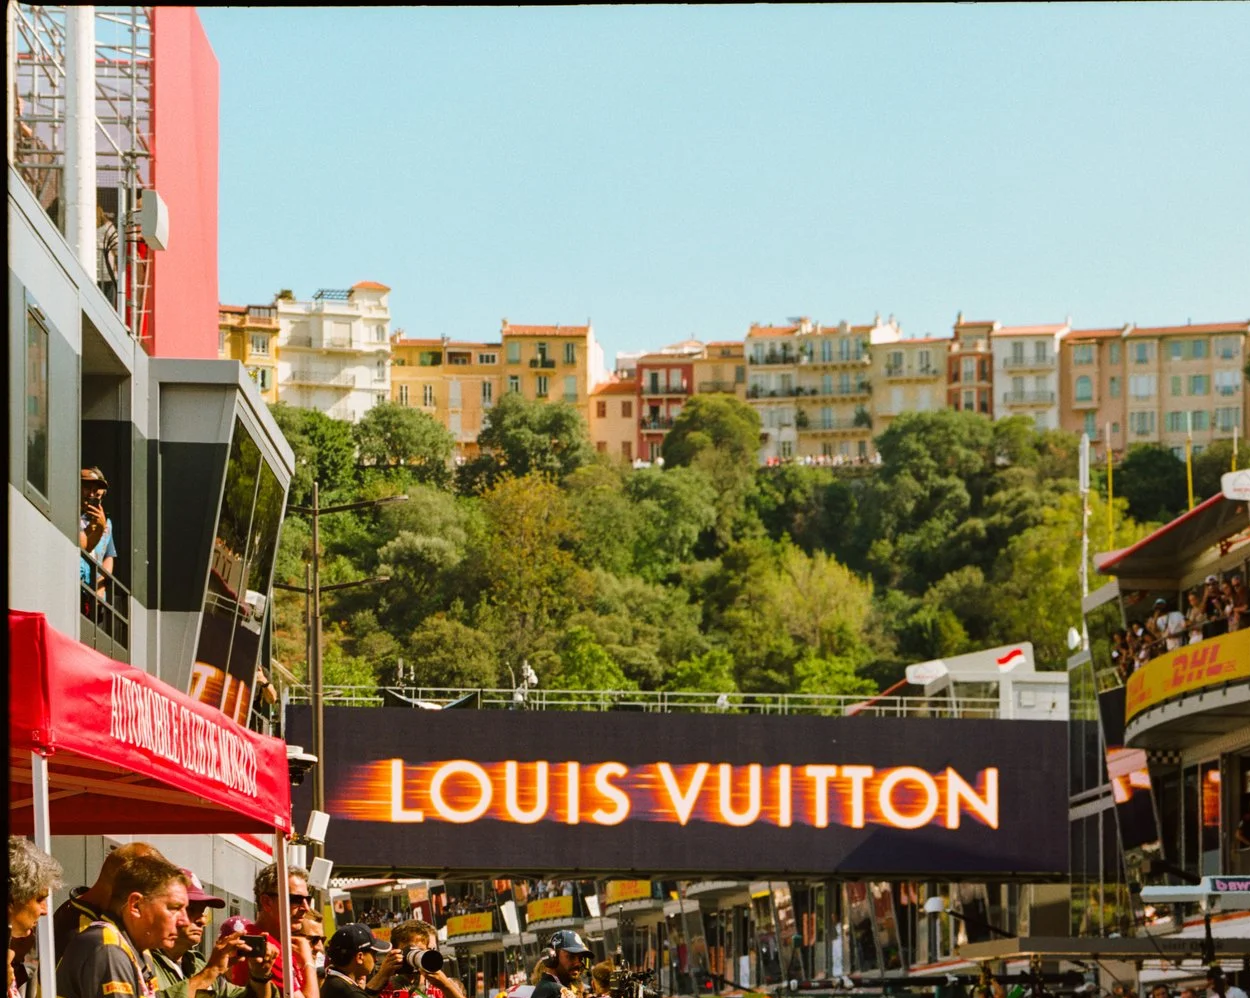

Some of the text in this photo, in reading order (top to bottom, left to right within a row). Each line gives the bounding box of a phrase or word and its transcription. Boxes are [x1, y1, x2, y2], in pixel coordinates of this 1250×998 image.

[1172, 644, 1223, 688] DHL
[110, 672, 258, 798] AUTOMOBILE CLUB DE MONACO
[391, 758, 1000, 830] LOUIS VUITTON
